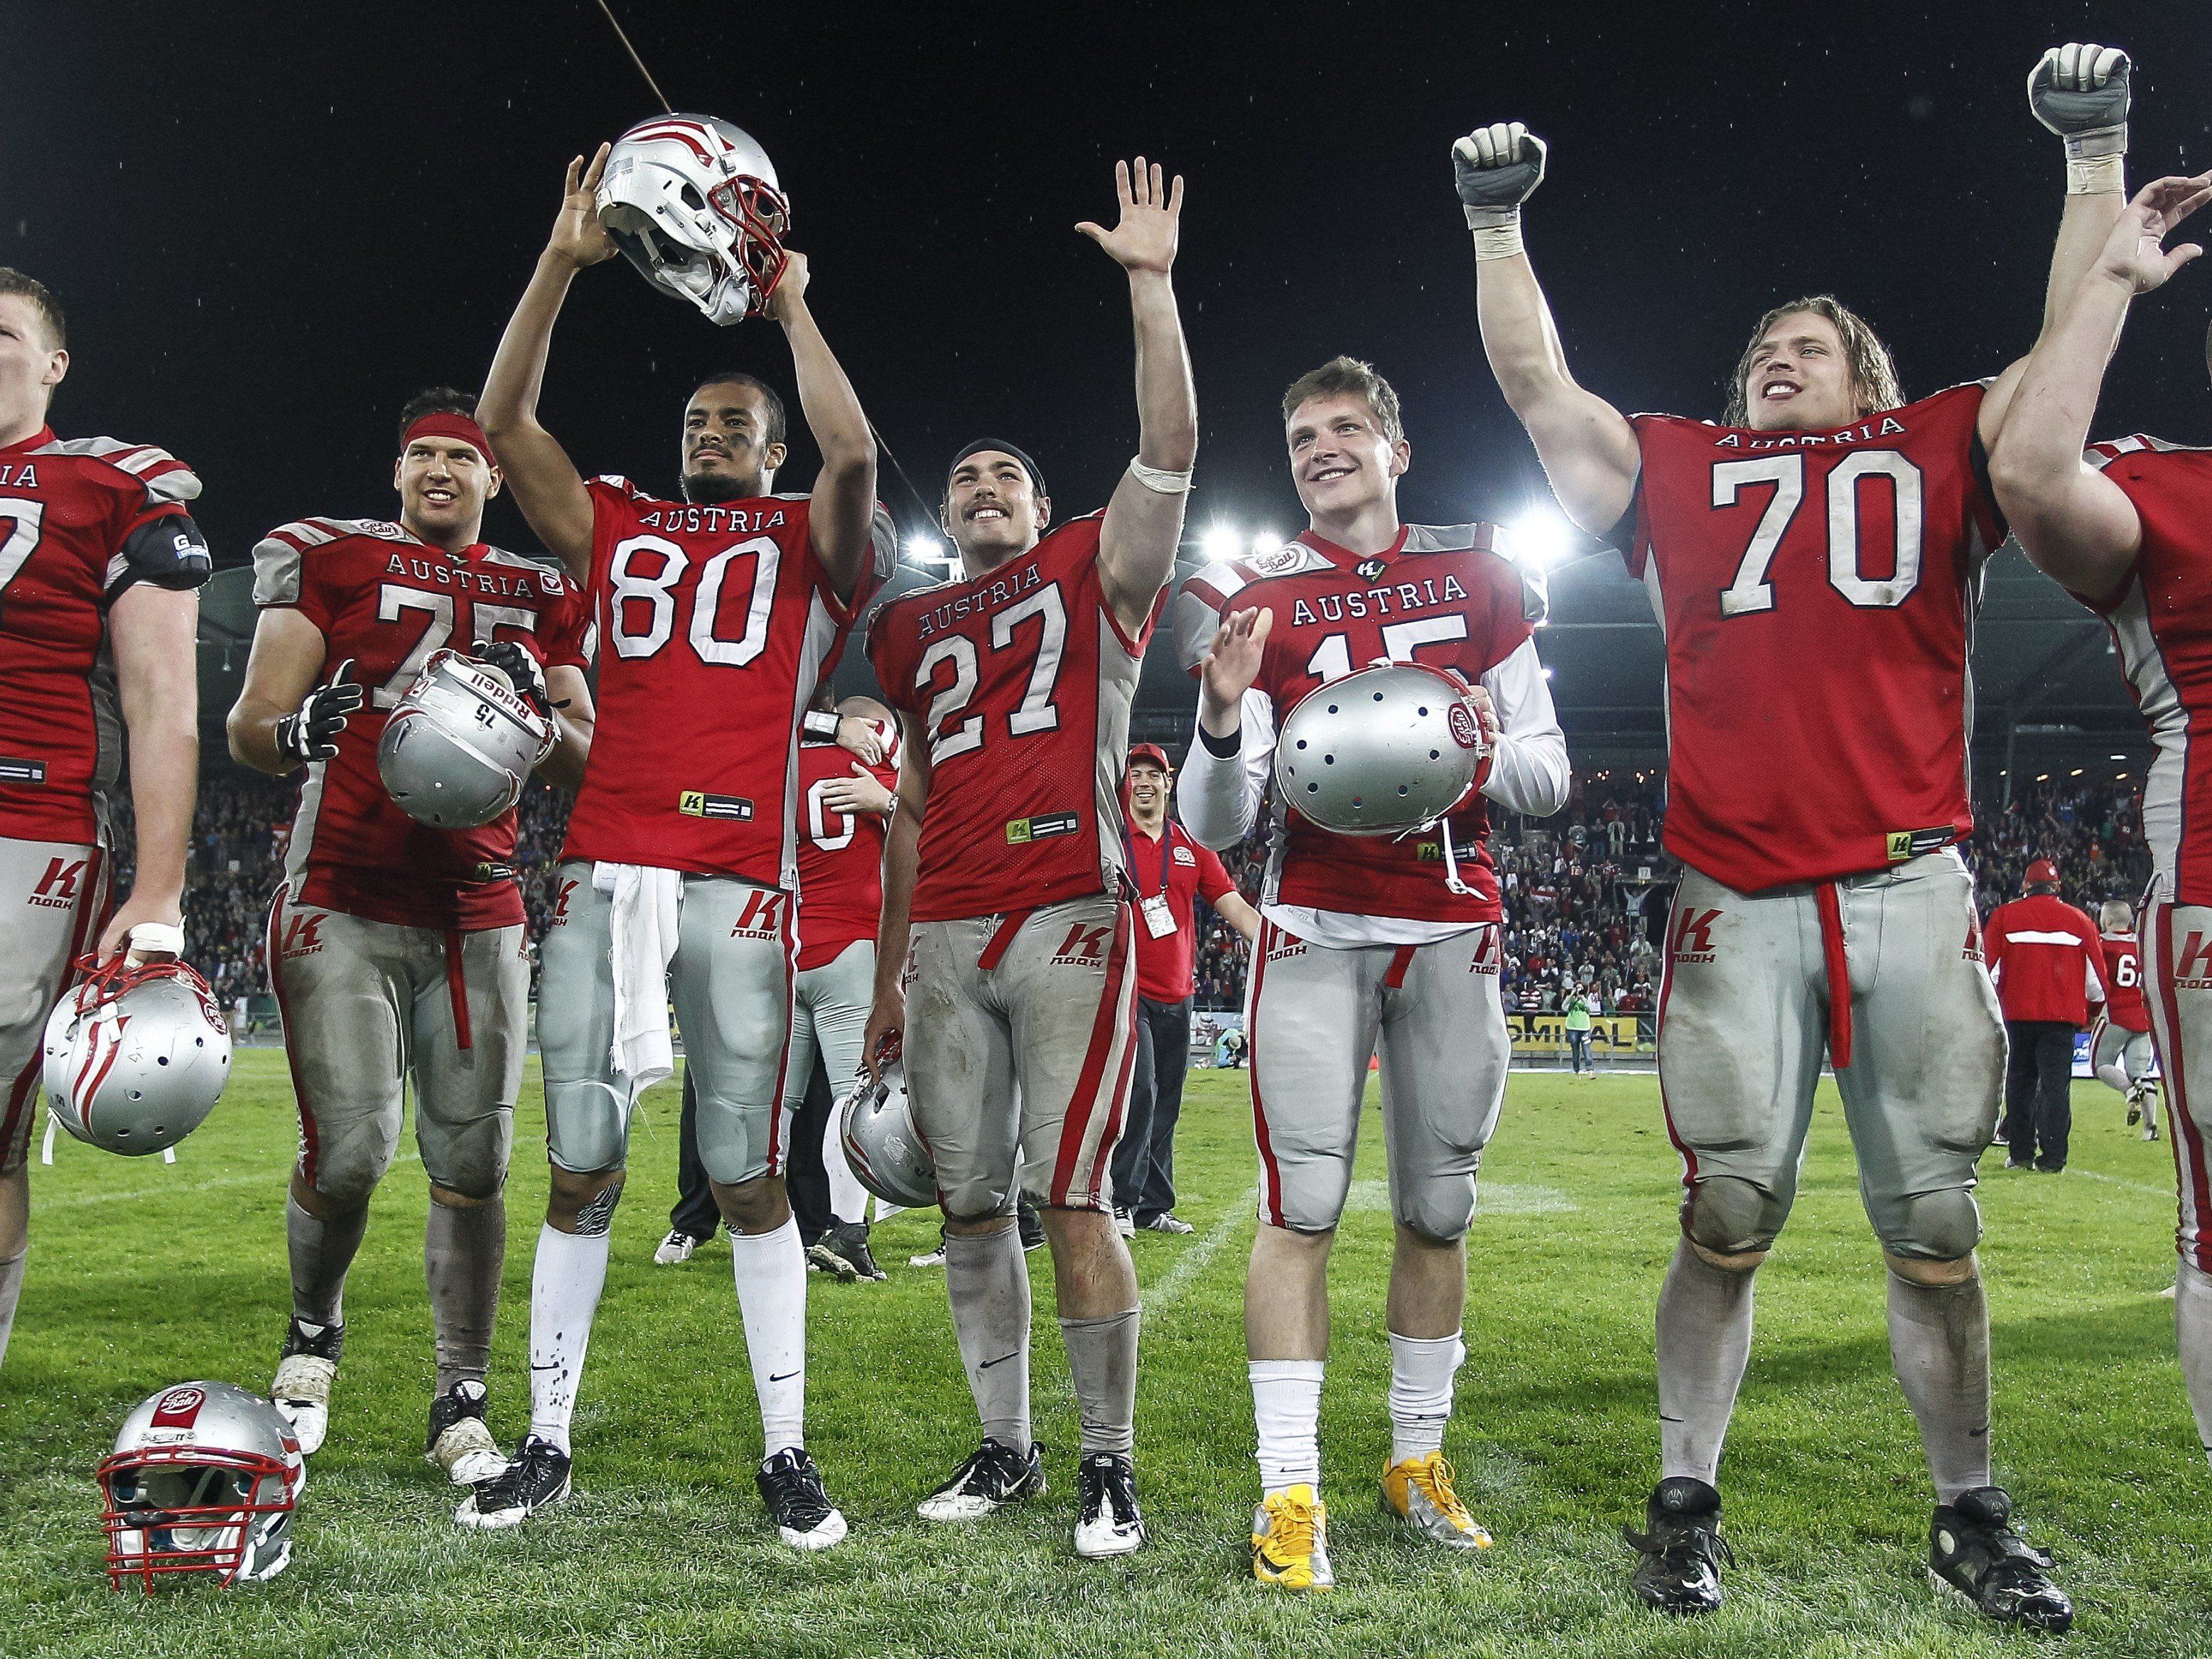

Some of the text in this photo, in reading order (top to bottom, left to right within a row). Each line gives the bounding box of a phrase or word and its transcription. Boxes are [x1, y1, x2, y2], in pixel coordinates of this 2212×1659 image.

[639, 507, 785, 532] AUSTRIA
[1713, 450, 1921, 615] 70
[387, 553, 534, 598] AUSTRIA
[610, 534, 781, 666] 80
[919, 563, 1042, 640] AUSTRIA
[1293, 574, 1467, 626] AUSTRIA
[915, 582, 1067, 768] 27
[2117, 953, 2142, 988] 6
